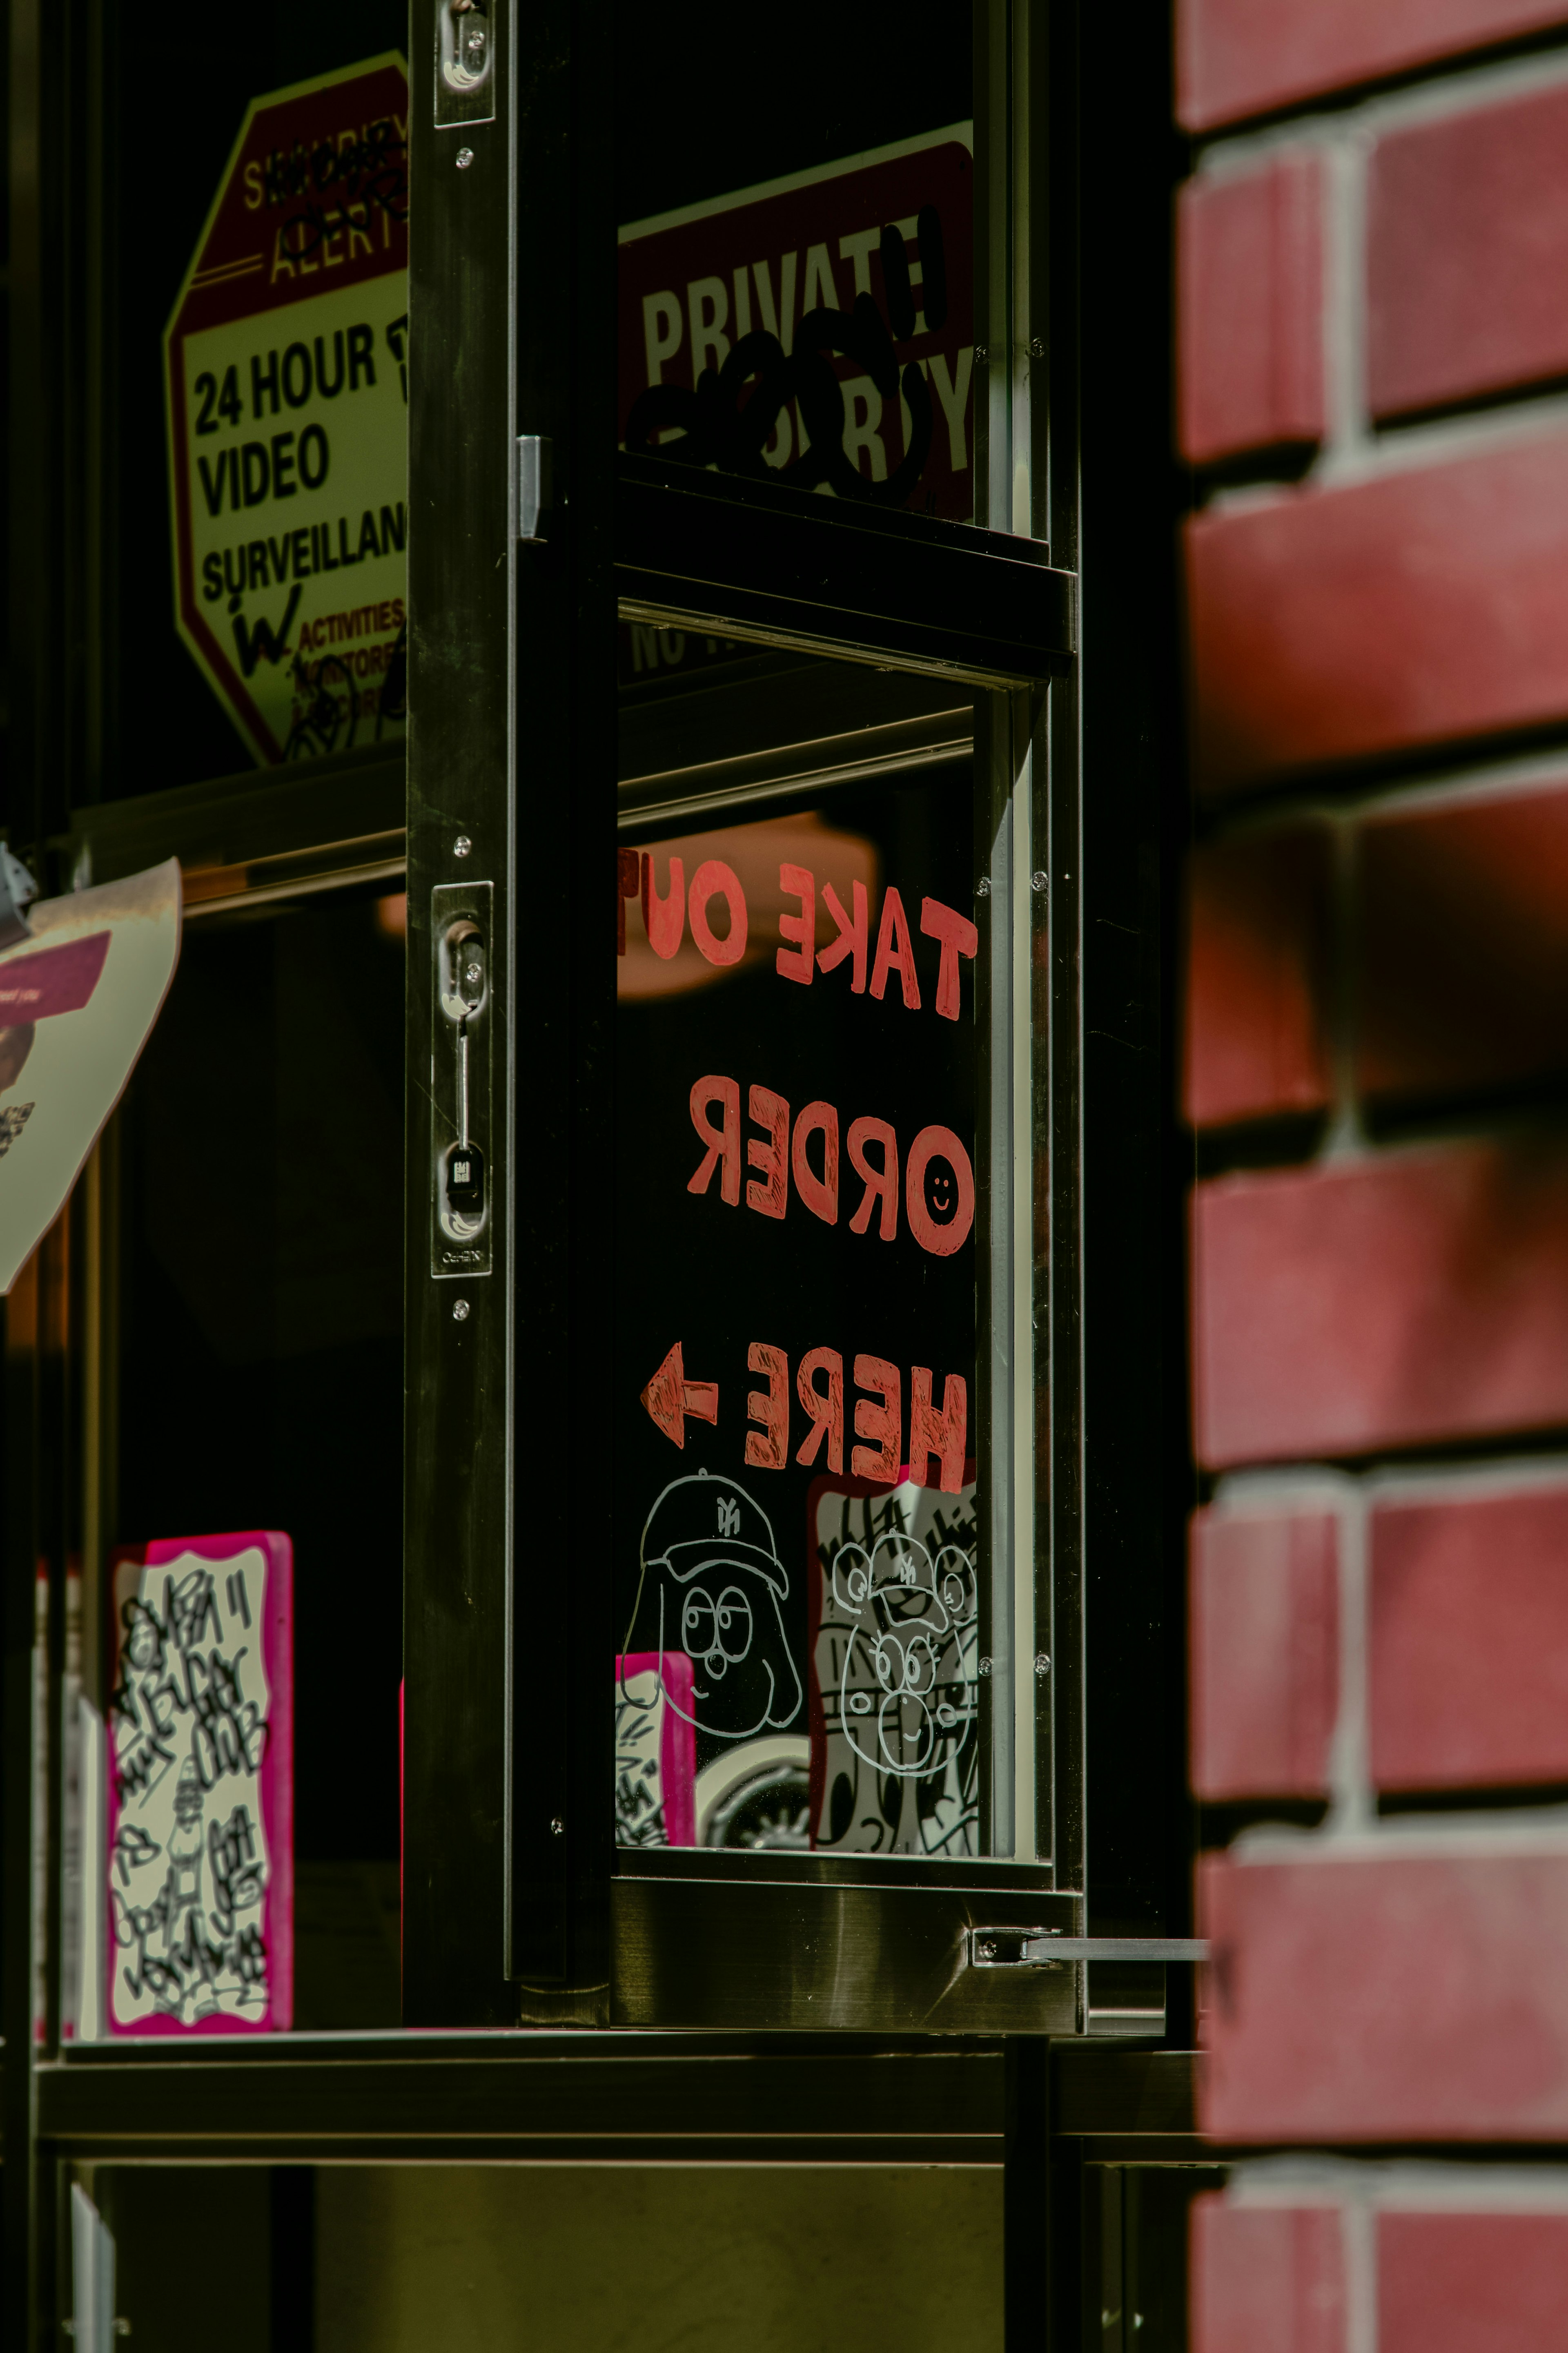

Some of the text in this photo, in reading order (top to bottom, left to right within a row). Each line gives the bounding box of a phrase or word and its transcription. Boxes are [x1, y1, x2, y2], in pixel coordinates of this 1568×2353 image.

[269, 192, 398, 285] ALERT
[641, 214, 934, 393] PRIVATE
[195, 322, 375, 435] 24 HOUR
[198, 424, 330, 517] VIDEO
[203, 502, 407, 601] SURVEILLAN
[299, 598, 404, 650] ACTIVITIES
